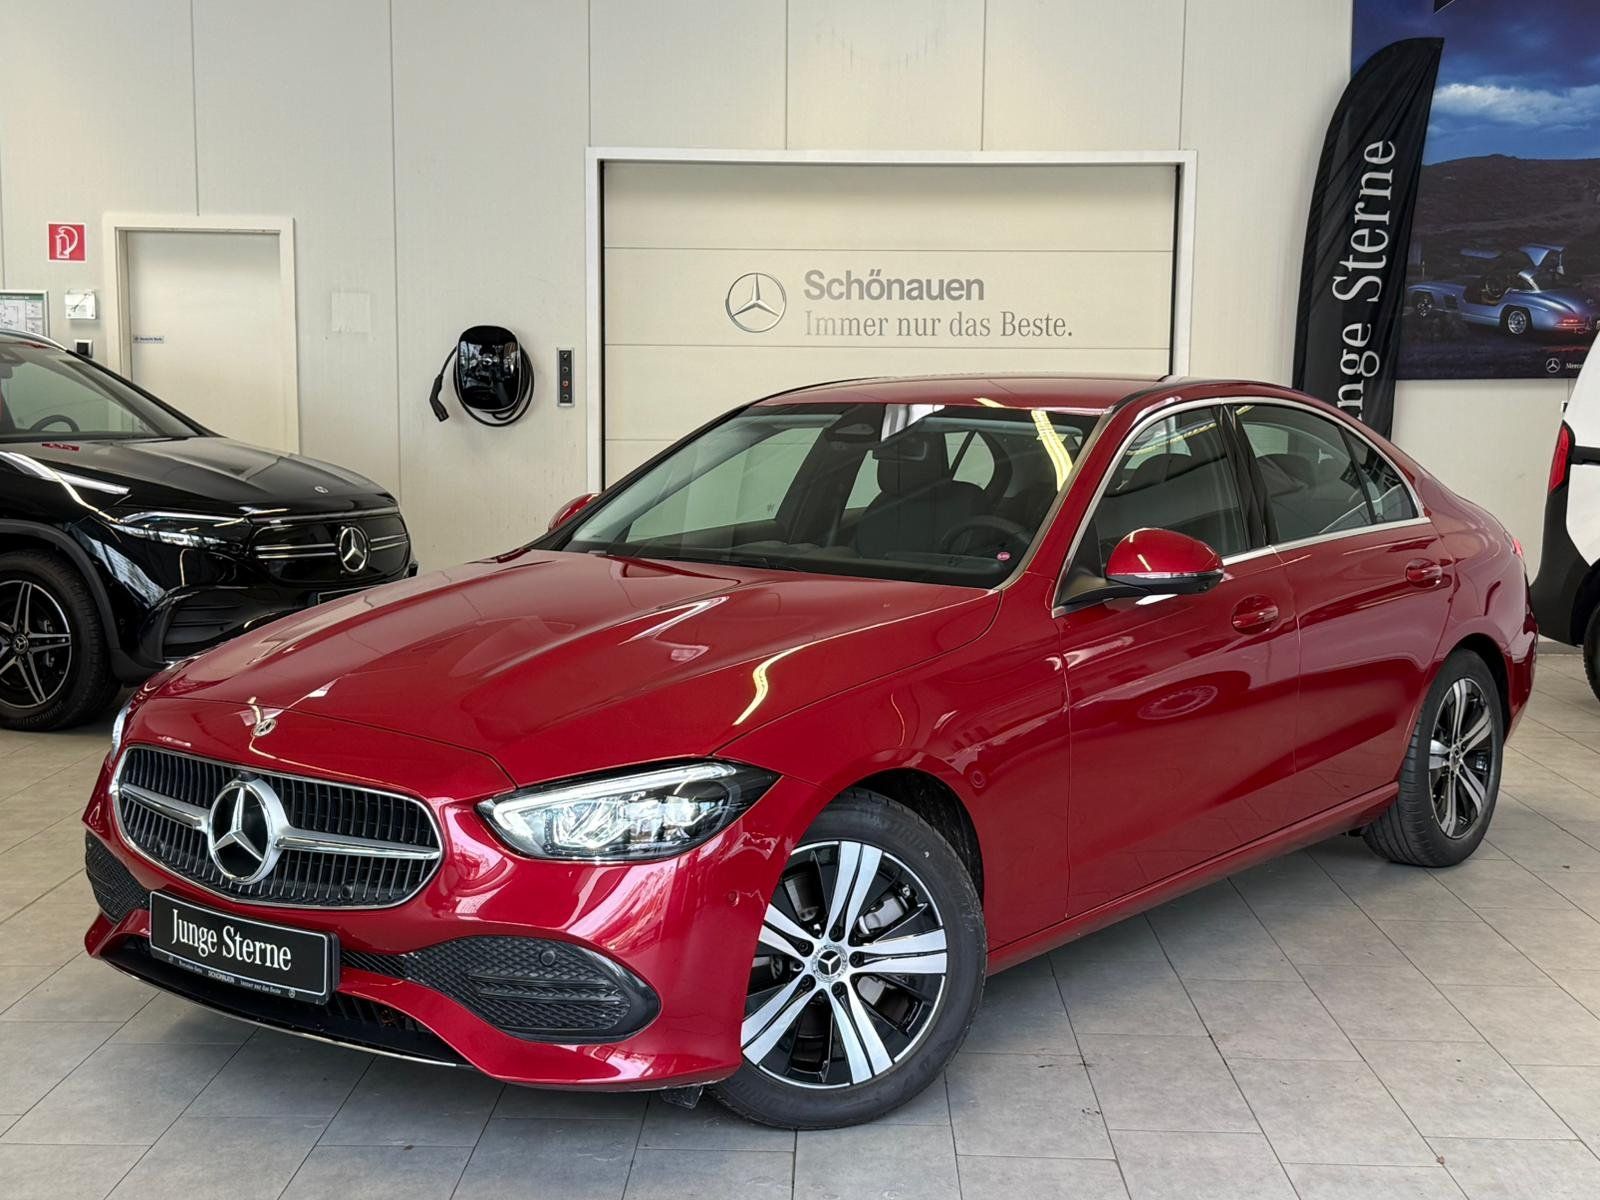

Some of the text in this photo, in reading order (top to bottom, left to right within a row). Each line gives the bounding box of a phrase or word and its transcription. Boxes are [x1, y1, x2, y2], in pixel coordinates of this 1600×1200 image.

[803, 268, 984, 301] Schönauen
[1332, 139, 1396, 421] nge Sterne
[804, 310, 1073, 337] Immer nur das Beste.
[171, 908, 292, 971] Junge Sterne
